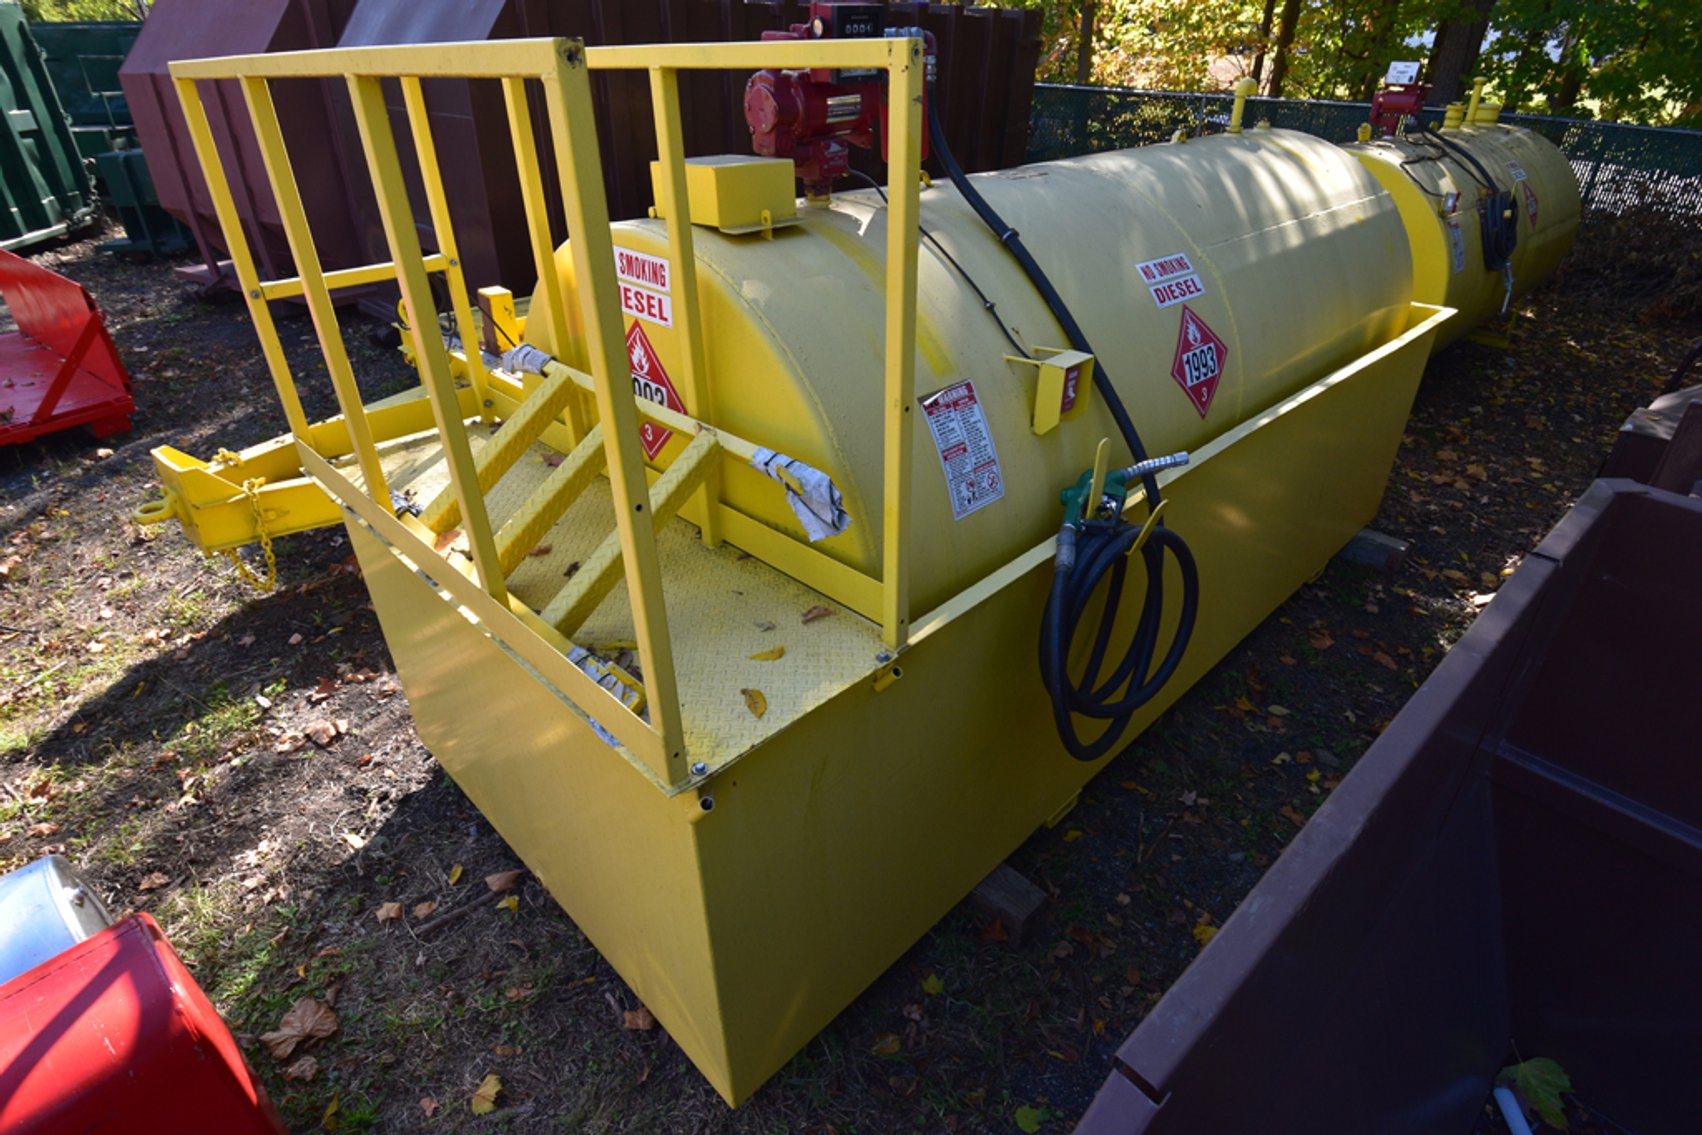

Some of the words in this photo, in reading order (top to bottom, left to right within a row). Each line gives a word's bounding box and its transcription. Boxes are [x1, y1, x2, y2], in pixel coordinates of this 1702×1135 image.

[618, 252, 666, 288] SMOKING
[1139, 265, 1156, 281] NO
[1154, 255, 1191, 277] SMOKING
[1153, 277, 1202, 304] DIESEL
[1184, 345, 1217, 384] 1993
[1200, 386, 1208, 402] 3
[644, 423, 653, 442] 3
